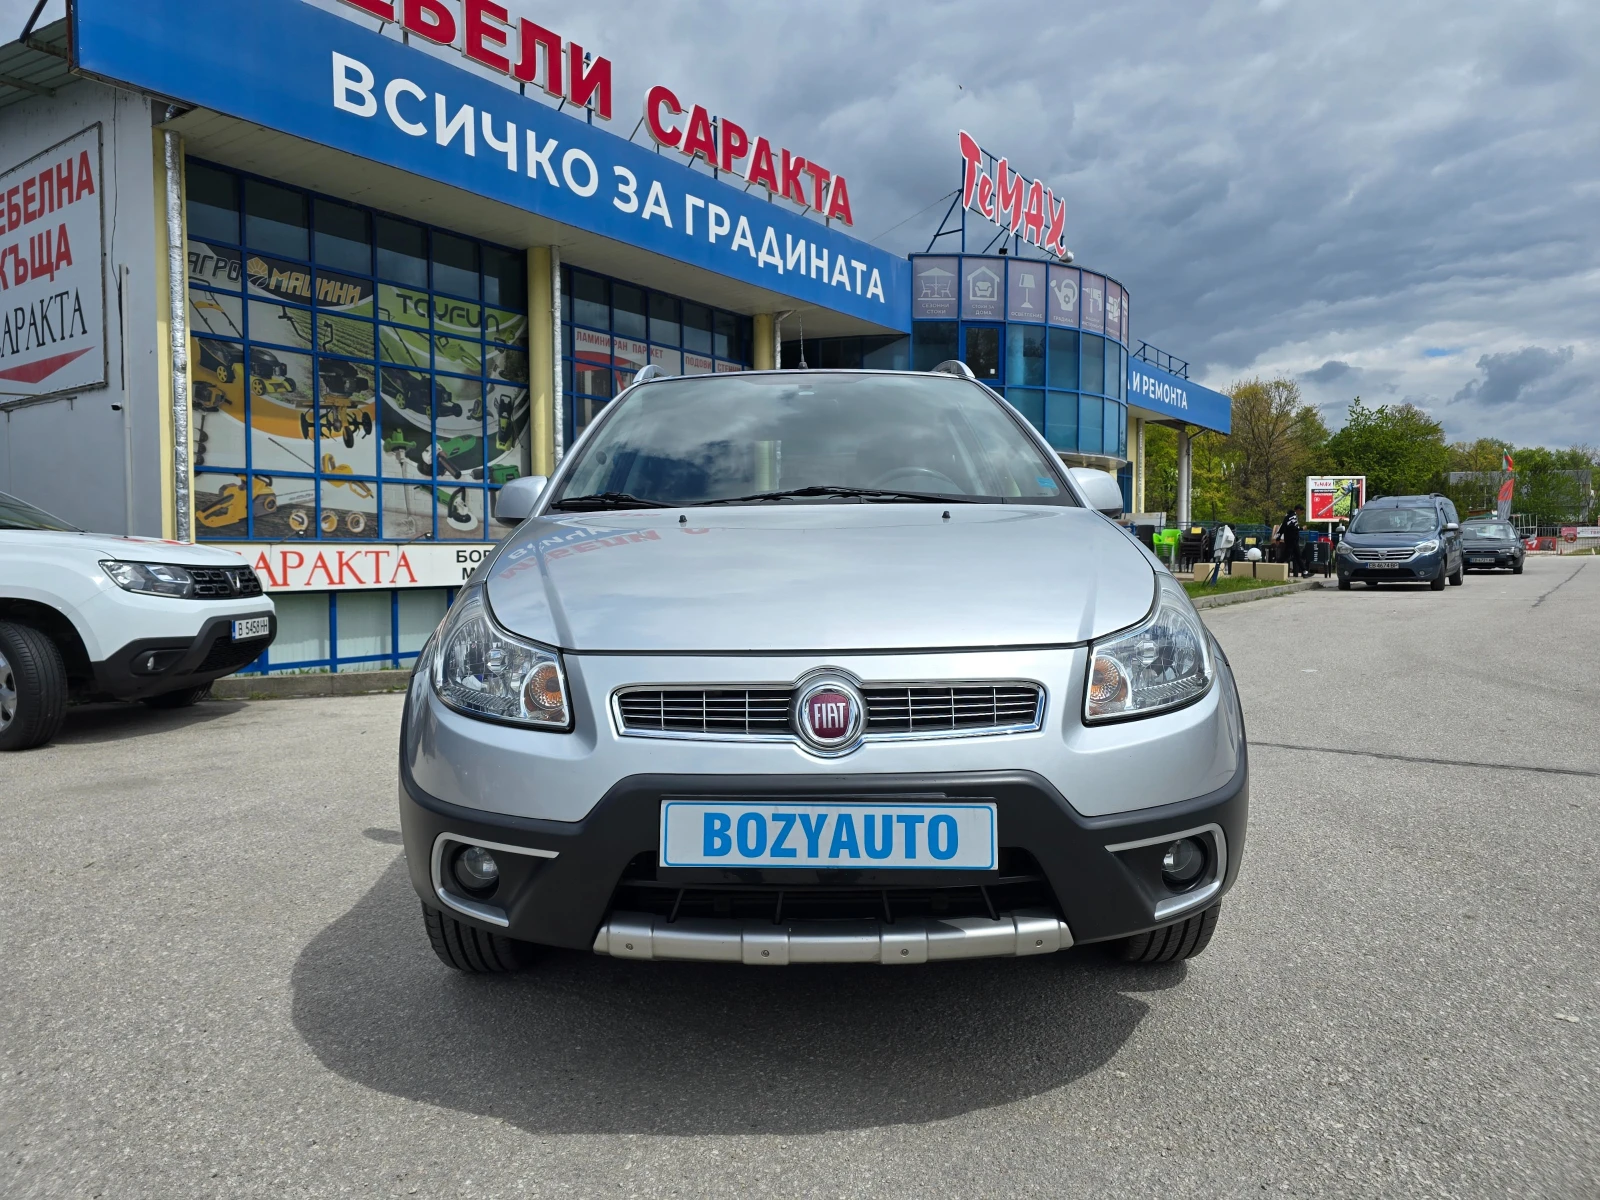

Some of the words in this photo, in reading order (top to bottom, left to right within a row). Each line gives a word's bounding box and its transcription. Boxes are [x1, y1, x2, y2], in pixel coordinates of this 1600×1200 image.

[335, 0, 611, 120] БЕЛИ
[643, 85, 853, 226] САРАКТА
[332, 51, 599, 197] ВСИЧКО
[613, 165, 673, 228] ЗА
[685, 193, 885, 303] ГРАДИНАТА
[187, 251, 242, 283] АГРО
[269, 267, 361, 305] МАШИНИ
[632, 343, 664, 359] ПАРКЕТ
[685, 356, 712, 369] ПОДОВИ
[1133, 371, 1140, 392] И
[1143, 375, 1188, 410] РЕМОНТА
[236, 550, 417, 587] АРАКТА
[814, 703, 846, 729] FIAT
[703, 812, 959, 860] BOZYAUTO
